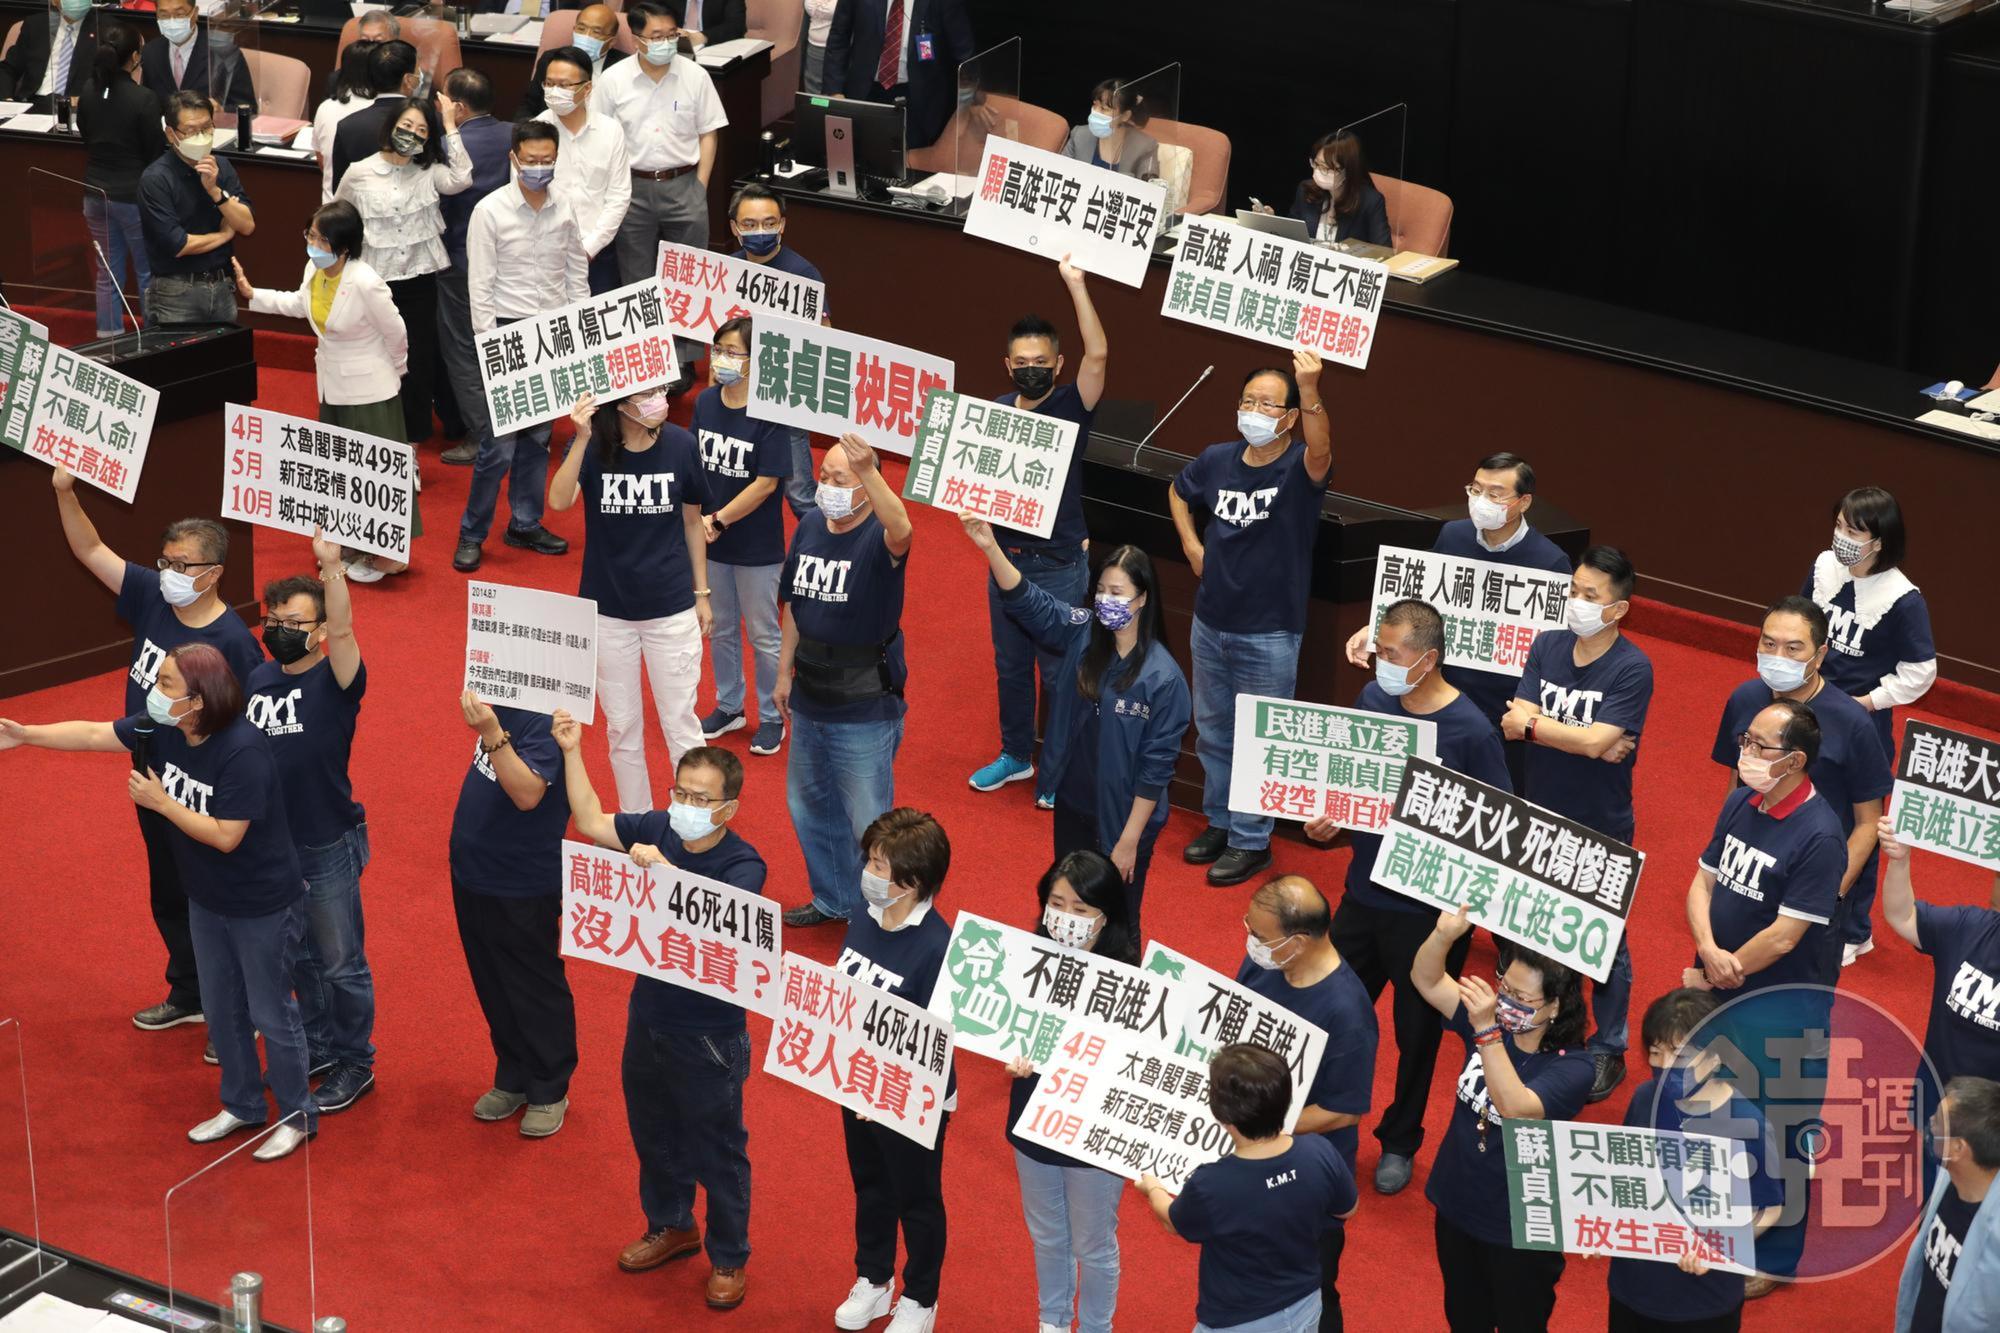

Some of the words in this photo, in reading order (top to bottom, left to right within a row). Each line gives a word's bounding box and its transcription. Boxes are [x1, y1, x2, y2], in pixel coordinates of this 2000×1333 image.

[980, 153, 1081, 226] 願高雄平安
[1083, 184, 1158, 251] 台灣平安
[662, 249, 728, 294] 高雄大火
[736, 269, 819, 321] 46死41傷
[1180, 223, 1231, 272] 高雄
[1233, 238, 1283, 287] 人禍
[1288, 251, 1383, 313] 傷亡不斷
[1168, 270, 1232, 324] 蘇貞昌
[481, 331, 528, 381] 高雄
[534, 311, 576, 365] 人禍
[578, 286, 666, 346] 傷亡不斷
[4, 341, 45, 444] 蘇貞昌
[51, 353, 147, 418] 只顧預算!
[490, 372, 549, 428] 蘇貞昌
[43, 388, 138, 454] 不顧人命!
[231, 414, 262, 443] 4月
[911, 396, 953, 499] 蘇貞昌
[961, 403, 1064, 453] 只顧預算!
[32, 425, 128, 491] 放生高雄!
[231, 449, 262, 480] 5月
[698, 428, 754, 470] KMT
[952, 439, 1054, 491] 不顧人命!
[231, 485, 272, 518] 10月
[600, 472, 675, 506] KMT
[600, 504, 621, 514] LEAN
[625, 506, 633, 514] IN
[638, 505, 674, 514] TOGETHER
[942, 476, 1044, 529] 放生高雄!
[1214, 486, 1278, 520] KMT
[792, 554, 852, 594] KMT
[1378, 553, 1427, 601] 高雄
[1429, 560, 1475, 611] 人禍
[1481, 569, 1568, 625] 傷亡不斷
[1540, 679, 1603, 724] KMT
[1264, 703, 1410, 759] 民進黨立委
[162, 762, 213, 817] KMT
[1262, 744, 1319, 783] 有空
[1327, 752, 1405, 794] 顧貞昌
[1906, 731, 2000, 801] 高雄大
[1259, 780, 1317, 819] 沒空
[1401, 770, 1519, 861] 高雄大火
[1519, 811, 1632, 912] 死傷慘重
[1718, 833, 1777, 890] KMT
[569, 853, 657, 913] 高雄大火
[667, 881, 775, 952] 46死41傷
[1382, 832, 1500, 918] 高雄立委
[1499, 876, 1611, 970] 忙挺3Q
[837, 946, 905, 992] KMT
[1022, 946, 1088, 1012] 不顧
[1085, 969, 1172, 1041] 高雄人
[783, 965, 857, 1032] 高雄大火
[862, 999, 949, 1077] 46死41傷
[1198, 981, 1252, 1044] 不顧
[1062, 1031, 1107, 1067] 4月
[1043, 1068, 1089, 1104] 5月
[1026, 1103, 1084, 1147] 10月
[1083, 1123, 1196, 1187] 城中城火災
[1569, 1128, 1729, 1176] 只顧預算!
[1266, 1169, 1297, 1189] K.M.T
[1514, 1126, 1557, 1245] 蘇貞昌
[1571, 1171, 1733, 1220] 不顧人命!
[1574, 1214, 1735, 1264] 放生高雄!
